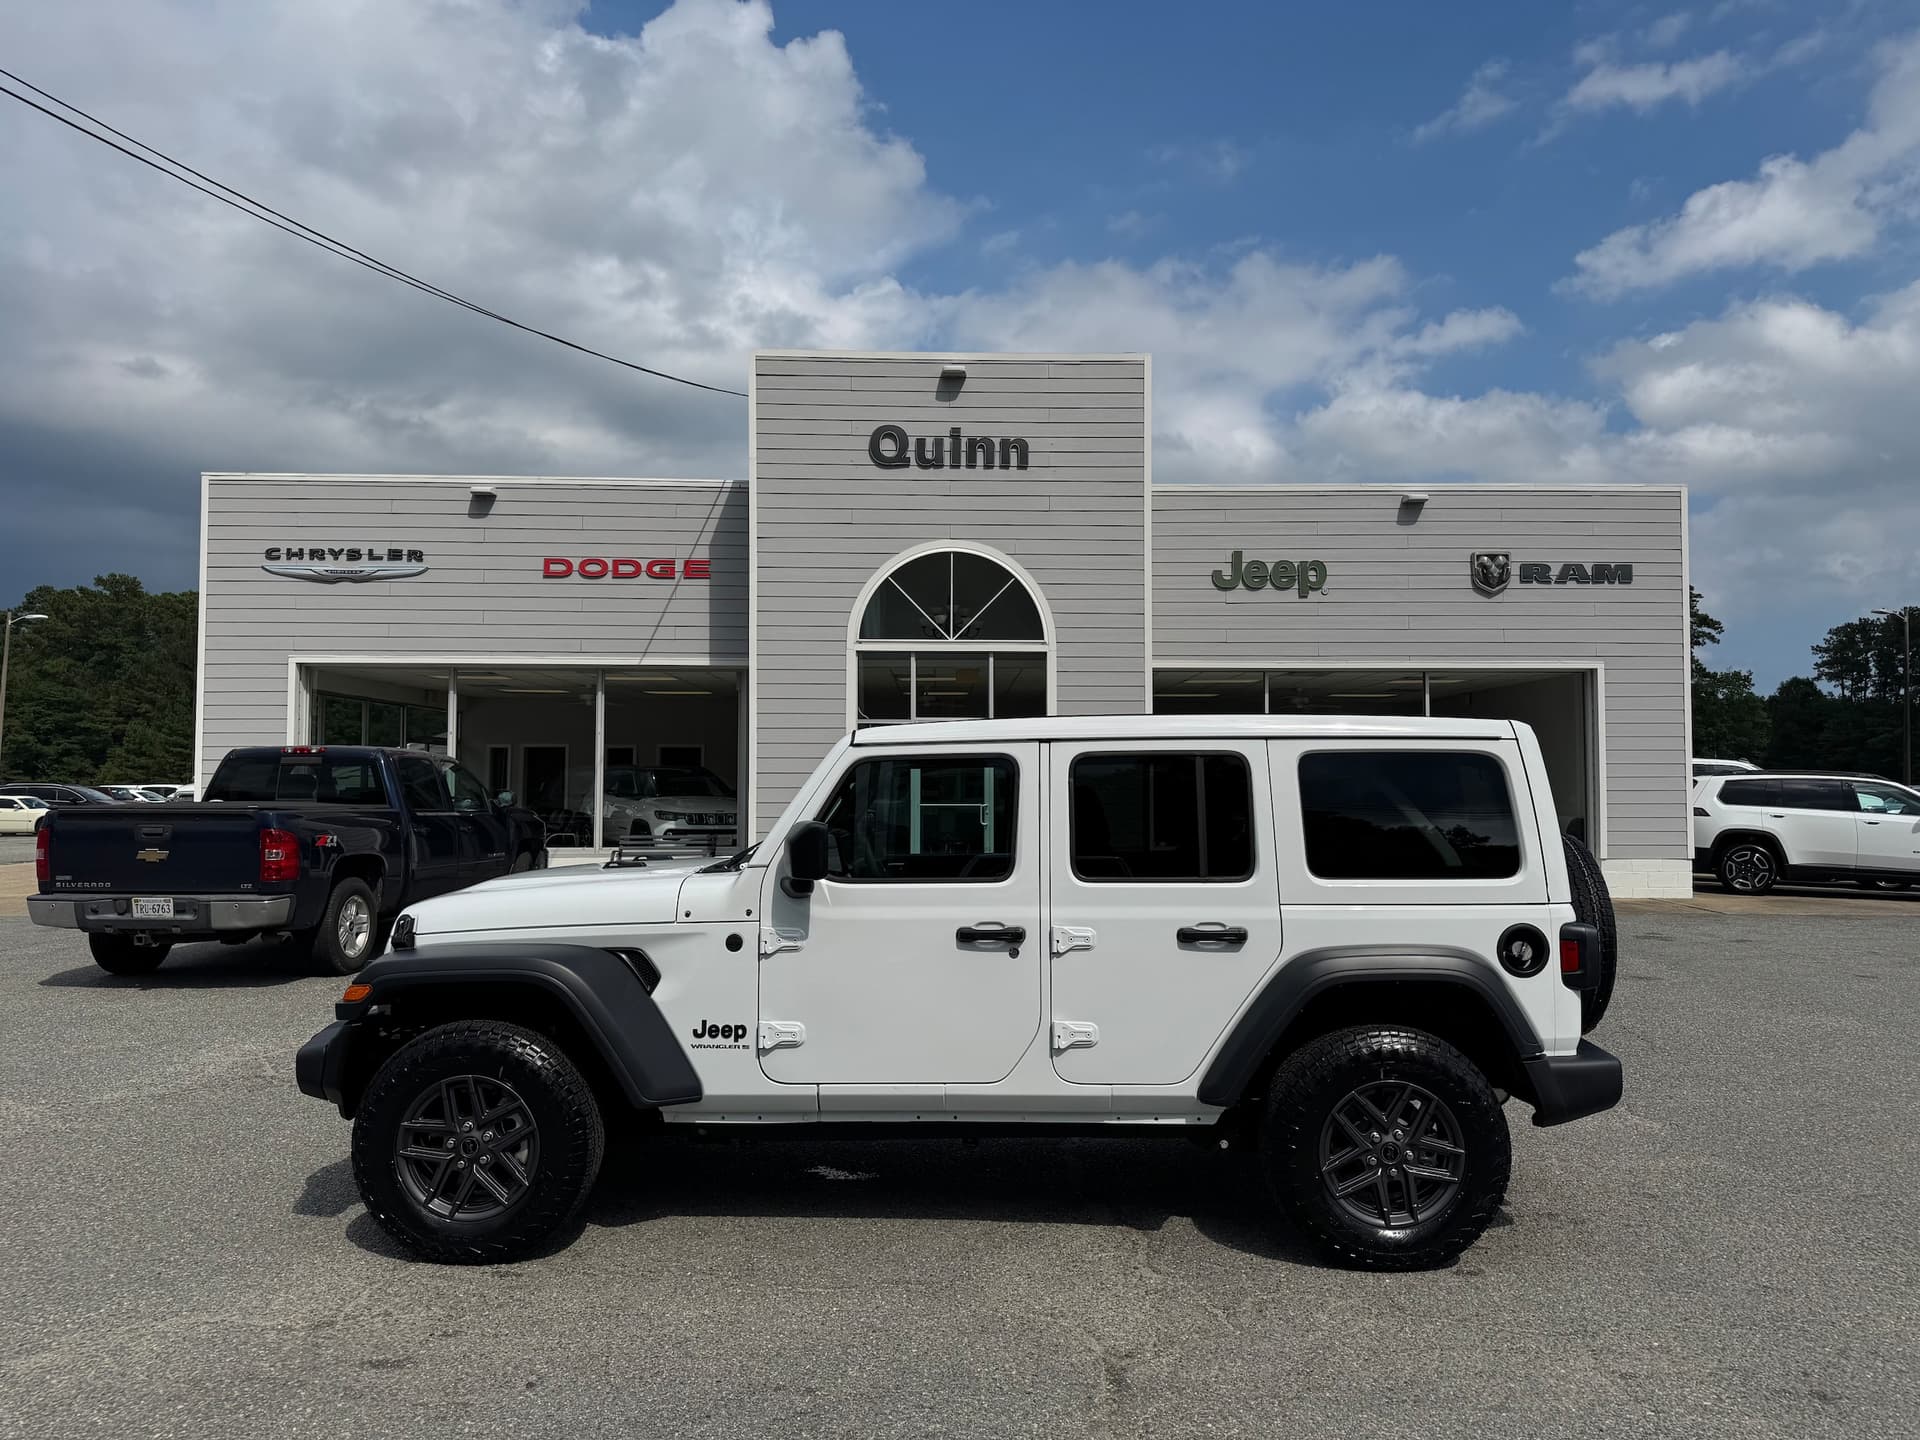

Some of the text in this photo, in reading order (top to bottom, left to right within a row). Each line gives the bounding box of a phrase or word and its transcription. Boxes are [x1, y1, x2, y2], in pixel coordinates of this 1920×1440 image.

[869, 424, 1029, 470] Quinn
[265, 547, 424, 562] CHRYSLER
[543, 558, 711, 579] DODGE
[1212, 550, 1327, 599] Jeep
[1519, 563, 1633, 585] RAM
[692, 1019, 747, 1043] Jeep
